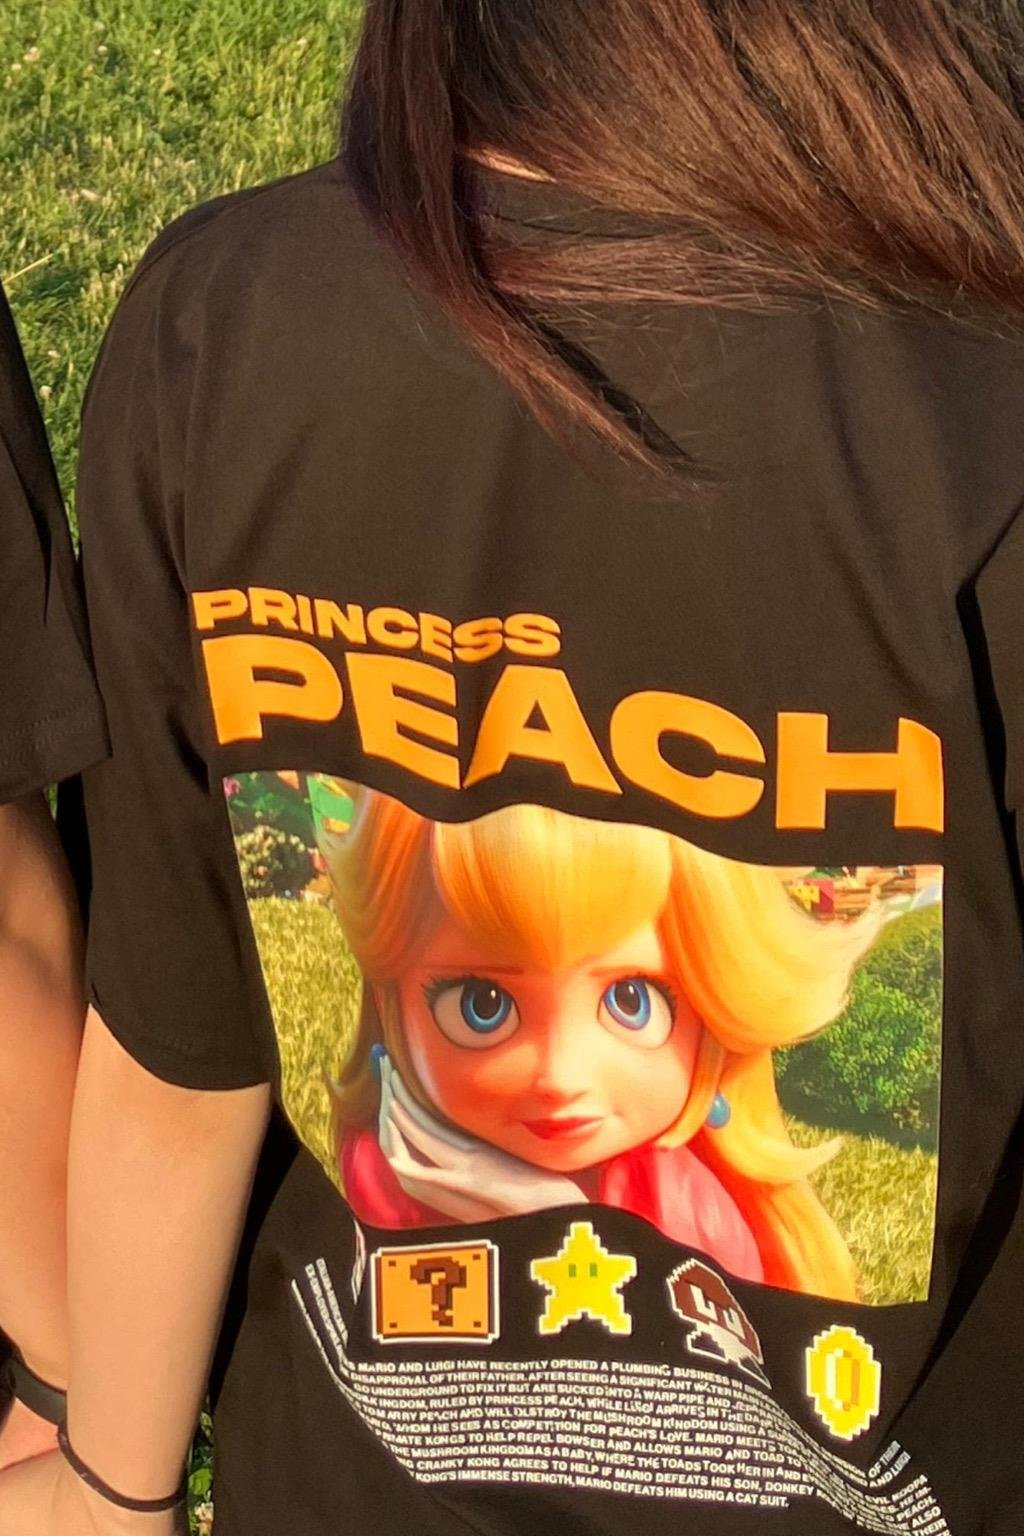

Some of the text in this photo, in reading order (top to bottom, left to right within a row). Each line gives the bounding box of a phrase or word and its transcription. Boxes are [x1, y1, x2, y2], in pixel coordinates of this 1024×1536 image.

[192, 587, 562, 663] PRINCESS
[202, 634, 945, 834] PEACH
[350, 1373, 428, 1384] DISAPPROVAL
[430, 1374, 444, 1383] OF
[447, 1372, 479, 1382] THEIR
[528, 1372, 565, 1381] AFTER
[567, 1372, 608, 1382] SEEING
[610, 1374, 617, 1384] A
[620, 1375, 692, 1390] SIGNIFICANT
[694, 1381, 731, 1396] WATER
[358, 1363, 395, 1372] MARIO
[398, 1363, 422, 1372] AND
[426, 1361, 454, 1372] LUIGI
[457, 1361, 487, 1369] HAVE
[490, 1360, 548, 1370] RECENTLY
[551, 1359, 598, 1370] OPENED
[601, 1361, 608, 1370] A
[611, 1363, 671, 1376] PLUMBING
[674, 1367, 730, 1385] BUSINESS
[731, 1379, 742, 1389] IN
[371, 1384, 458, 1397] UNDERGROUND
[460, 1384, 475, 1393] TO
[477, 1383, 494, 1392] FIX
[496, 1383, 506, 1392] IT
[509, 1383, 530, 1393] BUT
[533, 1383, 556, 1393] ARE
[558, 1383, 603, 1395] SUCKED
[605, 1385, 632, 1398] INTO
[634, 1387, 642, 1399] A
[643, 1389, 677, 1400] WARP
[679, 1393, 705, 1404] PIPE
[706, 1396, 730, 1408] AND
[430, 1397, 466, 1408] RULED
[469, 1396, 483, 1405] BY
[486, 1395, 542, 1405] PRINCESS
[544, 1395, 585, 1407] PEACH,
[587, 1398, 622, 1409] WHILE
[656, 1404, 705, 1418] ARRIVES
[706, 1407, 717, 1416] IN
[721, 1407, 742, 1422] THE
[375, 1409, 418, 1421] MARRY
[420, 1411, 458, 1421] PEACH
[460, 1409, 483, 1418] AND
[485, 1407, 511, 1418] WILL
[570, 1409, 592, 1420] THE
[593, 1411, 661, 1427] MUSHROOM
[664, 1417, 718, 1430] KINGDOM
[720, 1421, 756, 1434] USING
[758, 1428, 766, 1436] A
[433, 1422, 449, 1432] HE
[452, 1421, 480, 1431] SEES
[483, 1420, 500, 1429] AS
[502, 1420, 580, 1432] COMPETITION
[584, 1424, 606, 1435] FOR
[608, 1427, 656, 1439] PEACH'S
[660, 1430, 693, 1443] LOVE.
[696, 1432, 734, 1445] MARIO
[736, 1436, 776, 1451] MEETS
[412, 1445, 478, 1457] MUSHROOM
[481, 1445, 534, 1455] KINGDOM
[535, 1446, 551, 1456] AS
[553, 1447, 560, 1456] A
[562, 1447, 594, 1463] BABY,
[595, 1452, 635, 1466] WHERE
[638, 1458, 660, 1469] THE
[662, 1458, 702, 1472] TOADS
[703, 1460, 735, 1474] TOOK
[737, 1463, 761, 1477] HER
[762, 1467, 774, 1477] IN
[776, 1467, 800, 1481] AND
[426, 1435, 465, 1444] KONGS
[468, 1433, 484, 1443] TO
[486, 1432, 515, 1442] HELP
[517, 1432, 554, 1443] REPEL
[556, 1434, 605, 1449] BOWSER
[607, 1440, 631, 1451] AND
[634, 1442, 681, 1455] ALLOWS
[684, 1446, 722, 1457] MARIO
[726, 1449, 750, 1461] AND
[753, 1450, 785, 1463] TOAD
[787, 1456, 801, 1467] TO
[416, 1471, 789, 1507] KONG'S IMMENSE STRENGTH, MARIO DEFEATS HIM USING A CAT SUIT.
[417, 1458, 814, 1496] CRANKY KONG AGREES TO HELP IF MARIO DEFEATS HIS SON, DONKEY
